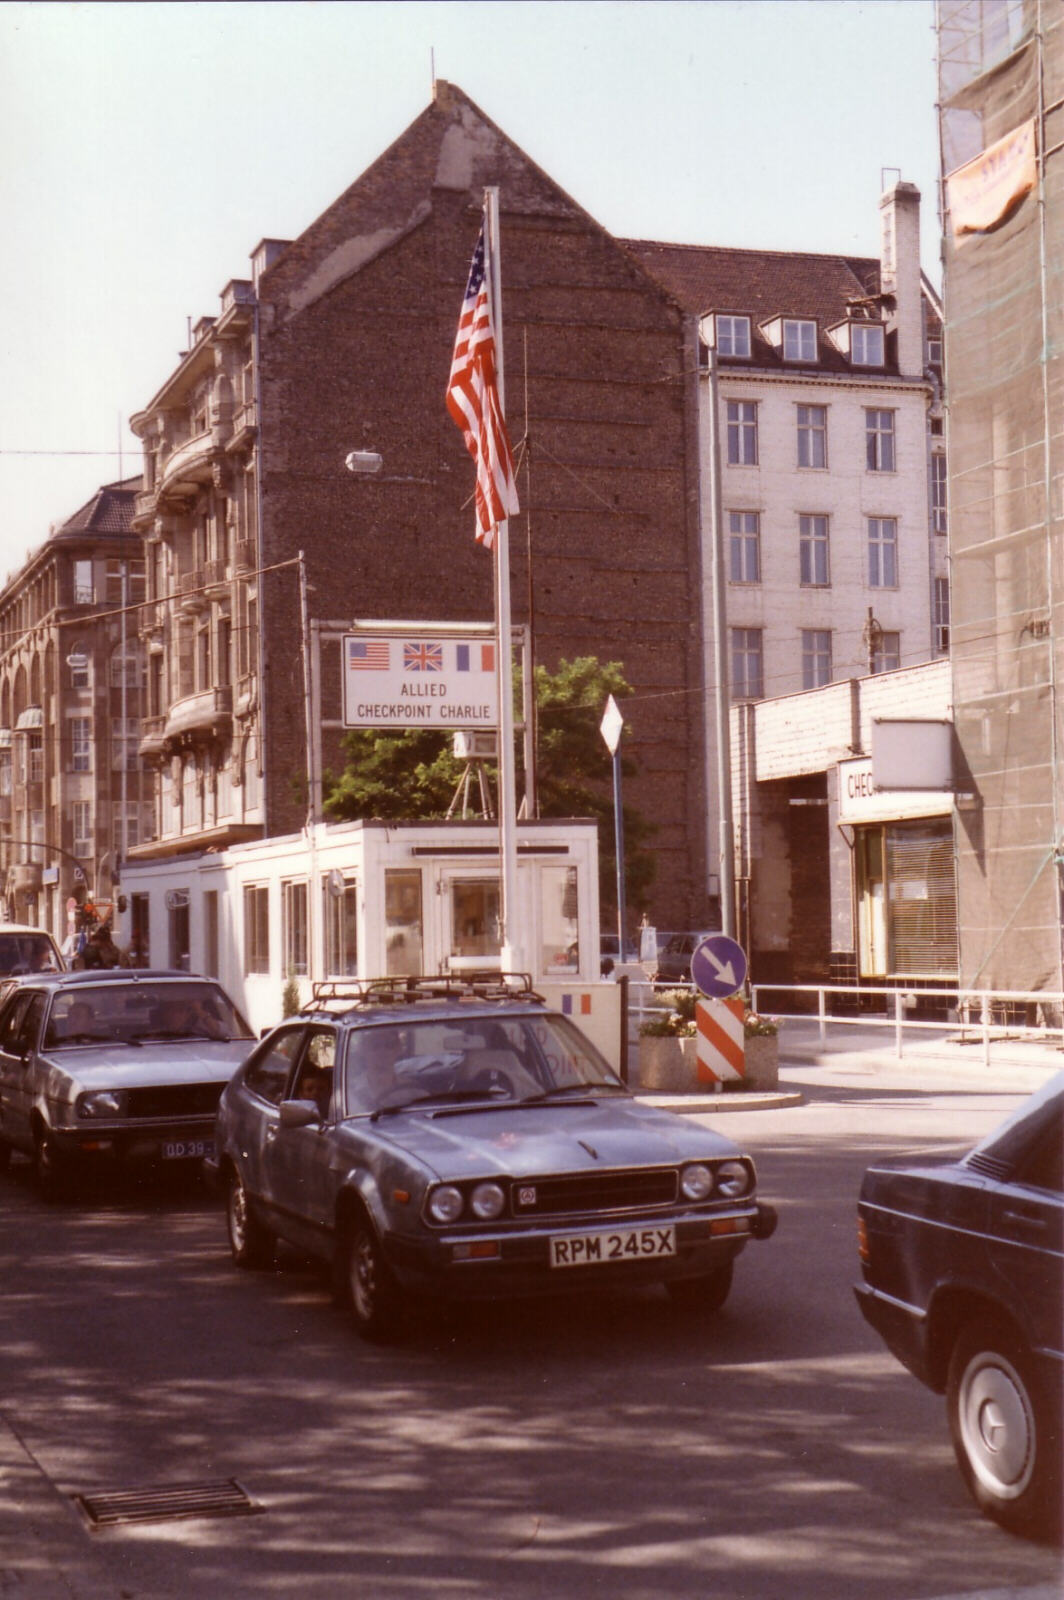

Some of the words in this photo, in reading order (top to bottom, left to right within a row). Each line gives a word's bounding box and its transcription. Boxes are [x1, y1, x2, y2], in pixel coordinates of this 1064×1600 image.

[400, 683, 447, 697] ALLIED
[357, 704, 432, 718] CHECKPOINT
[440, 705, 491, 719] CHARLIE
[848, 772, 873, 799] CHEC
[554, 1236, 601, 1264] RPM
[607, 1230, 673, 1259] 245X
